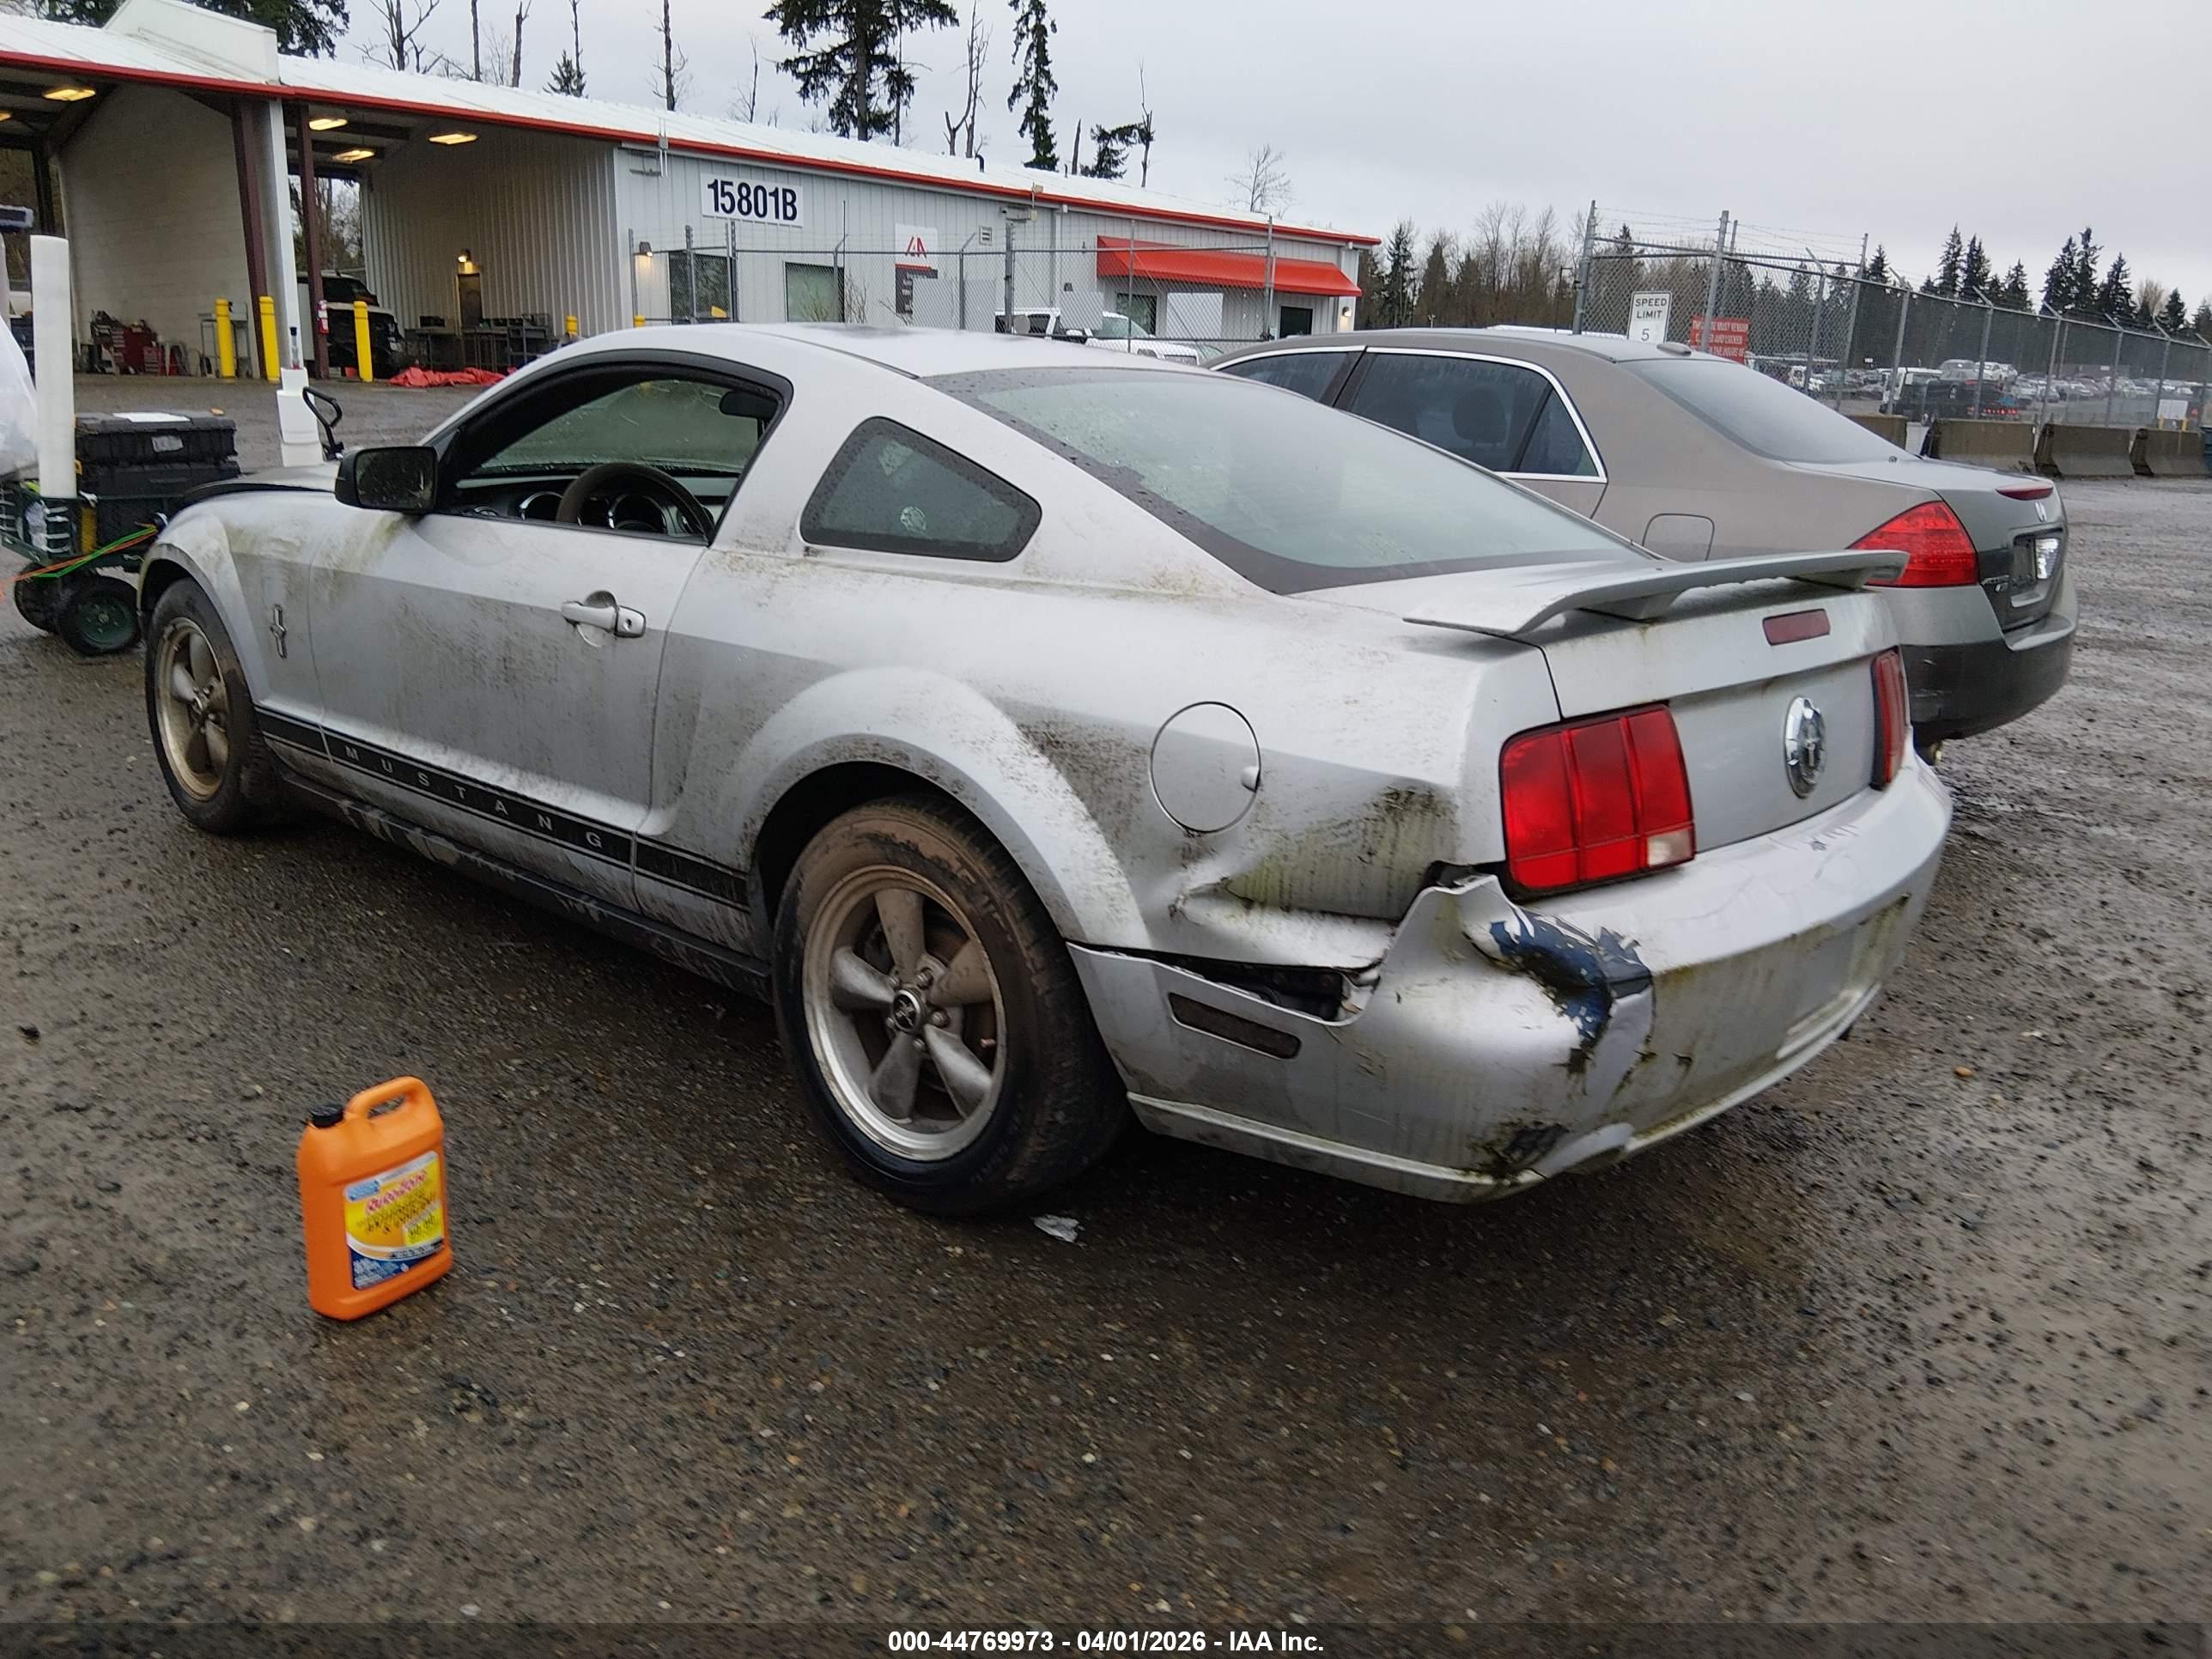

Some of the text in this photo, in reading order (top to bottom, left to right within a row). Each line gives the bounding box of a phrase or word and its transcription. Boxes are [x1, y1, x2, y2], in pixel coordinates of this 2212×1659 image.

[707, 178, 798, 222] 15801B
[1634, 297, 1668, 307] SPEED
[1636, 310, 1662, 319] LIMIT
[1641, 328, 1650, 342] 5
[344, 744, 603, 848] MUSTANG
